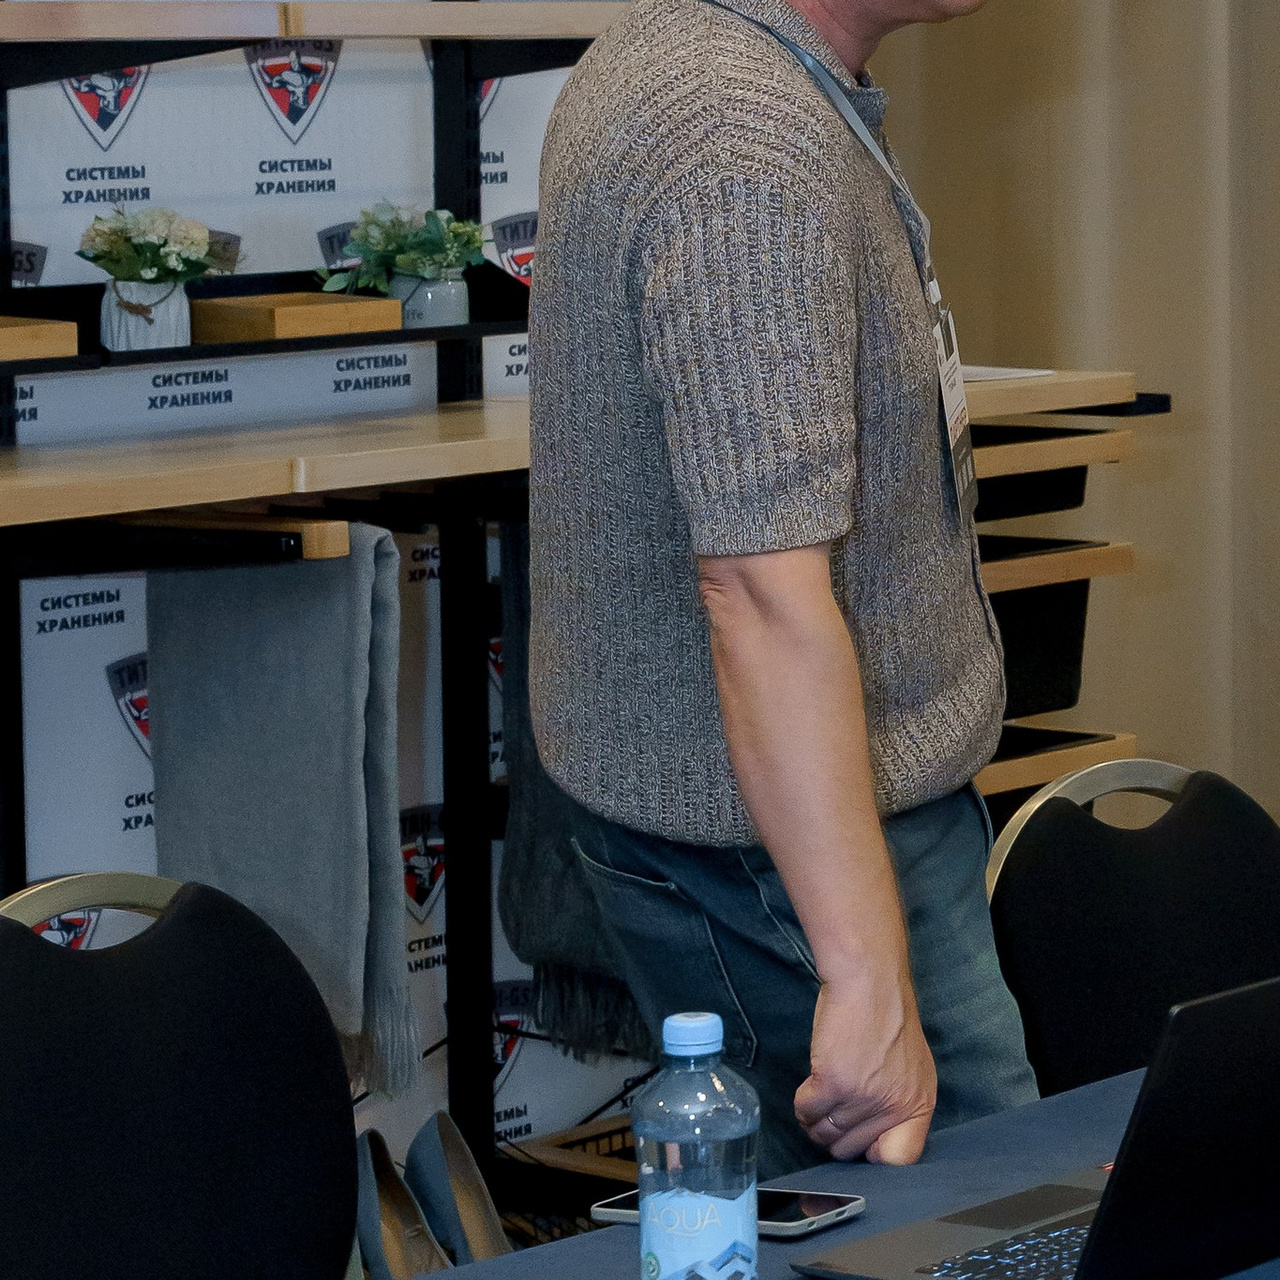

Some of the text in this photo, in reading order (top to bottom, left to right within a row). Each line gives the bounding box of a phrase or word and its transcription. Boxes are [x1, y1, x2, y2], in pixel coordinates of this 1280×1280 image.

[65, 166, 146, 182] СИСТЕМЫ
[258, 158, 332, 173] СИСТЕМЫ
[62, 187, 150, 204] ХРАНЕНИЯ
[255, 179, 336, 195] ХРАНЕНИЯ
[336, 354, 407, 371] СИСТЕМЫ
[152, 369, 229, 388] СИСТЕМЫ
[333, 374, 411, 393] ХРАНЕНИЯ
[147, 390, 233, 410] ХРАНЕНИЯ
[40, 589, 120, 611] СИСТЕМЫ
[36, 609, 125, 634] ХРАНЕНИЯ
[407, 933, 443, 953] СТЕМ
[646, 1200, 722, 1236] AQUA
